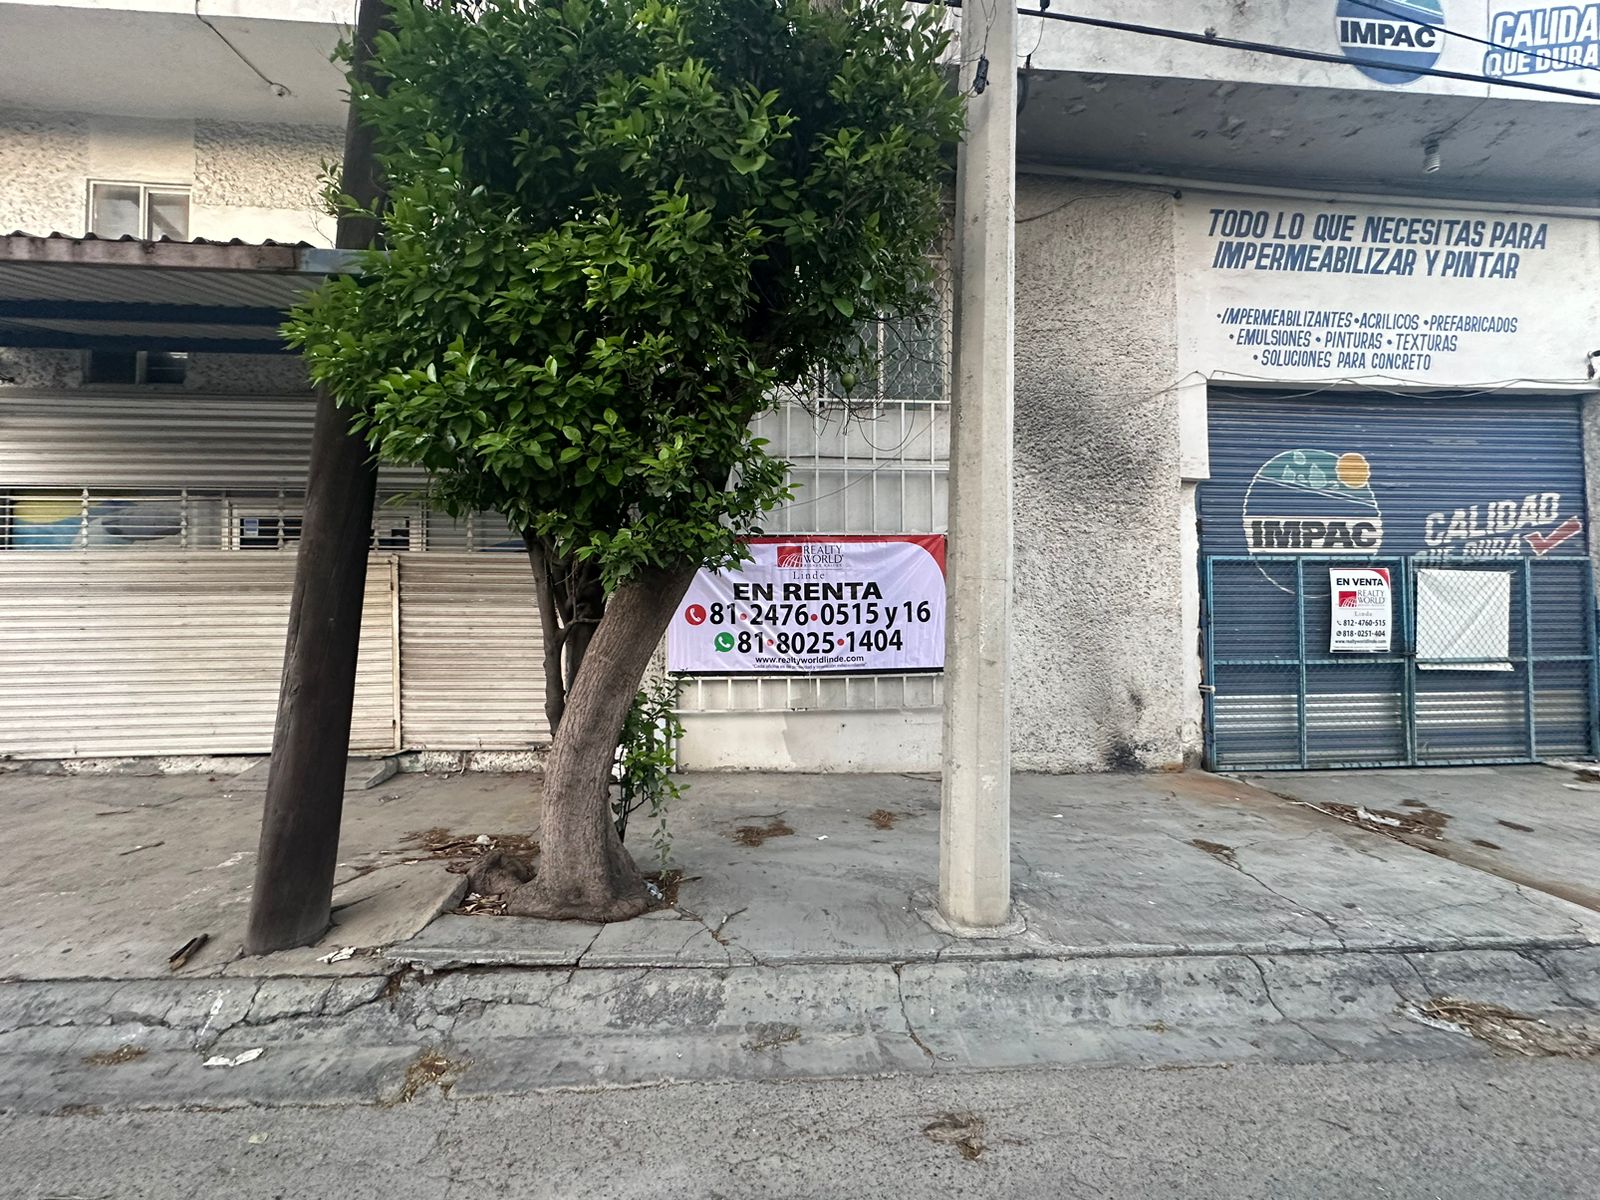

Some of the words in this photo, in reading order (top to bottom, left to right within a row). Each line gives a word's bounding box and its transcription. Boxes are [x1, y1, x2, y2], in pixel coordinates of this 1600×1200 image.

[1340, 20, 1436, 48] IMPAC
[1492, 4, 1600, 49] CALIDA
[1484, 49, 1532, 76] QUE
[1535, 43, 1599, 73] DURA
[1208, 209, 1269, 239] TODO
[1272, 211, 1305, 239] LO
[1313, 213, 1357, 242] QUE
[1362, 216, 1486, 247] NECESITAS
[1489, 221, 1548, 249] PARA
[1212, 241, 1417, 276] IMPERMEABILIZAR
[1426, 249, 1440, 276] Y
[1441, 250, 1520, 279] PINTAR
[1429, 314, 1518, 333] PREFABRICADOS
[1236, 328, 1312, 347] EMULSIONES
[1324, 331, 1383, 349] PINTURAS
[1396, 333, 1458, 352] TEXTURAS
[1261, 349, 1332, 368] SOLUCIONES
[1337, 351, 1366, 369] PARA
[1371, 352, 1432, 371] CONCRETO
[1424, 492, 1561, 546] CALIDAD
[1251, 520, 1377, 548] IMPAC
[803, 545, 842, 555] REALTY
[803, 554, 843, 564] WORLD
[793, 570, 825, 580] Linde
[1336, 577, 1350, 586] EN
[1352, 578, 1384, 586] VENTA
[733, 582, 774, 601] EN
[783, 582, 883, 601] RENTA
[1357, 589, 1385, 597] REALTY
[1357, 596, 1385, 604] WORLD
[884, 606, 898, 630] y
[903, 601, 931, 623] 16
[755, 655, 865, 666] www.realtyworldlinde.com
